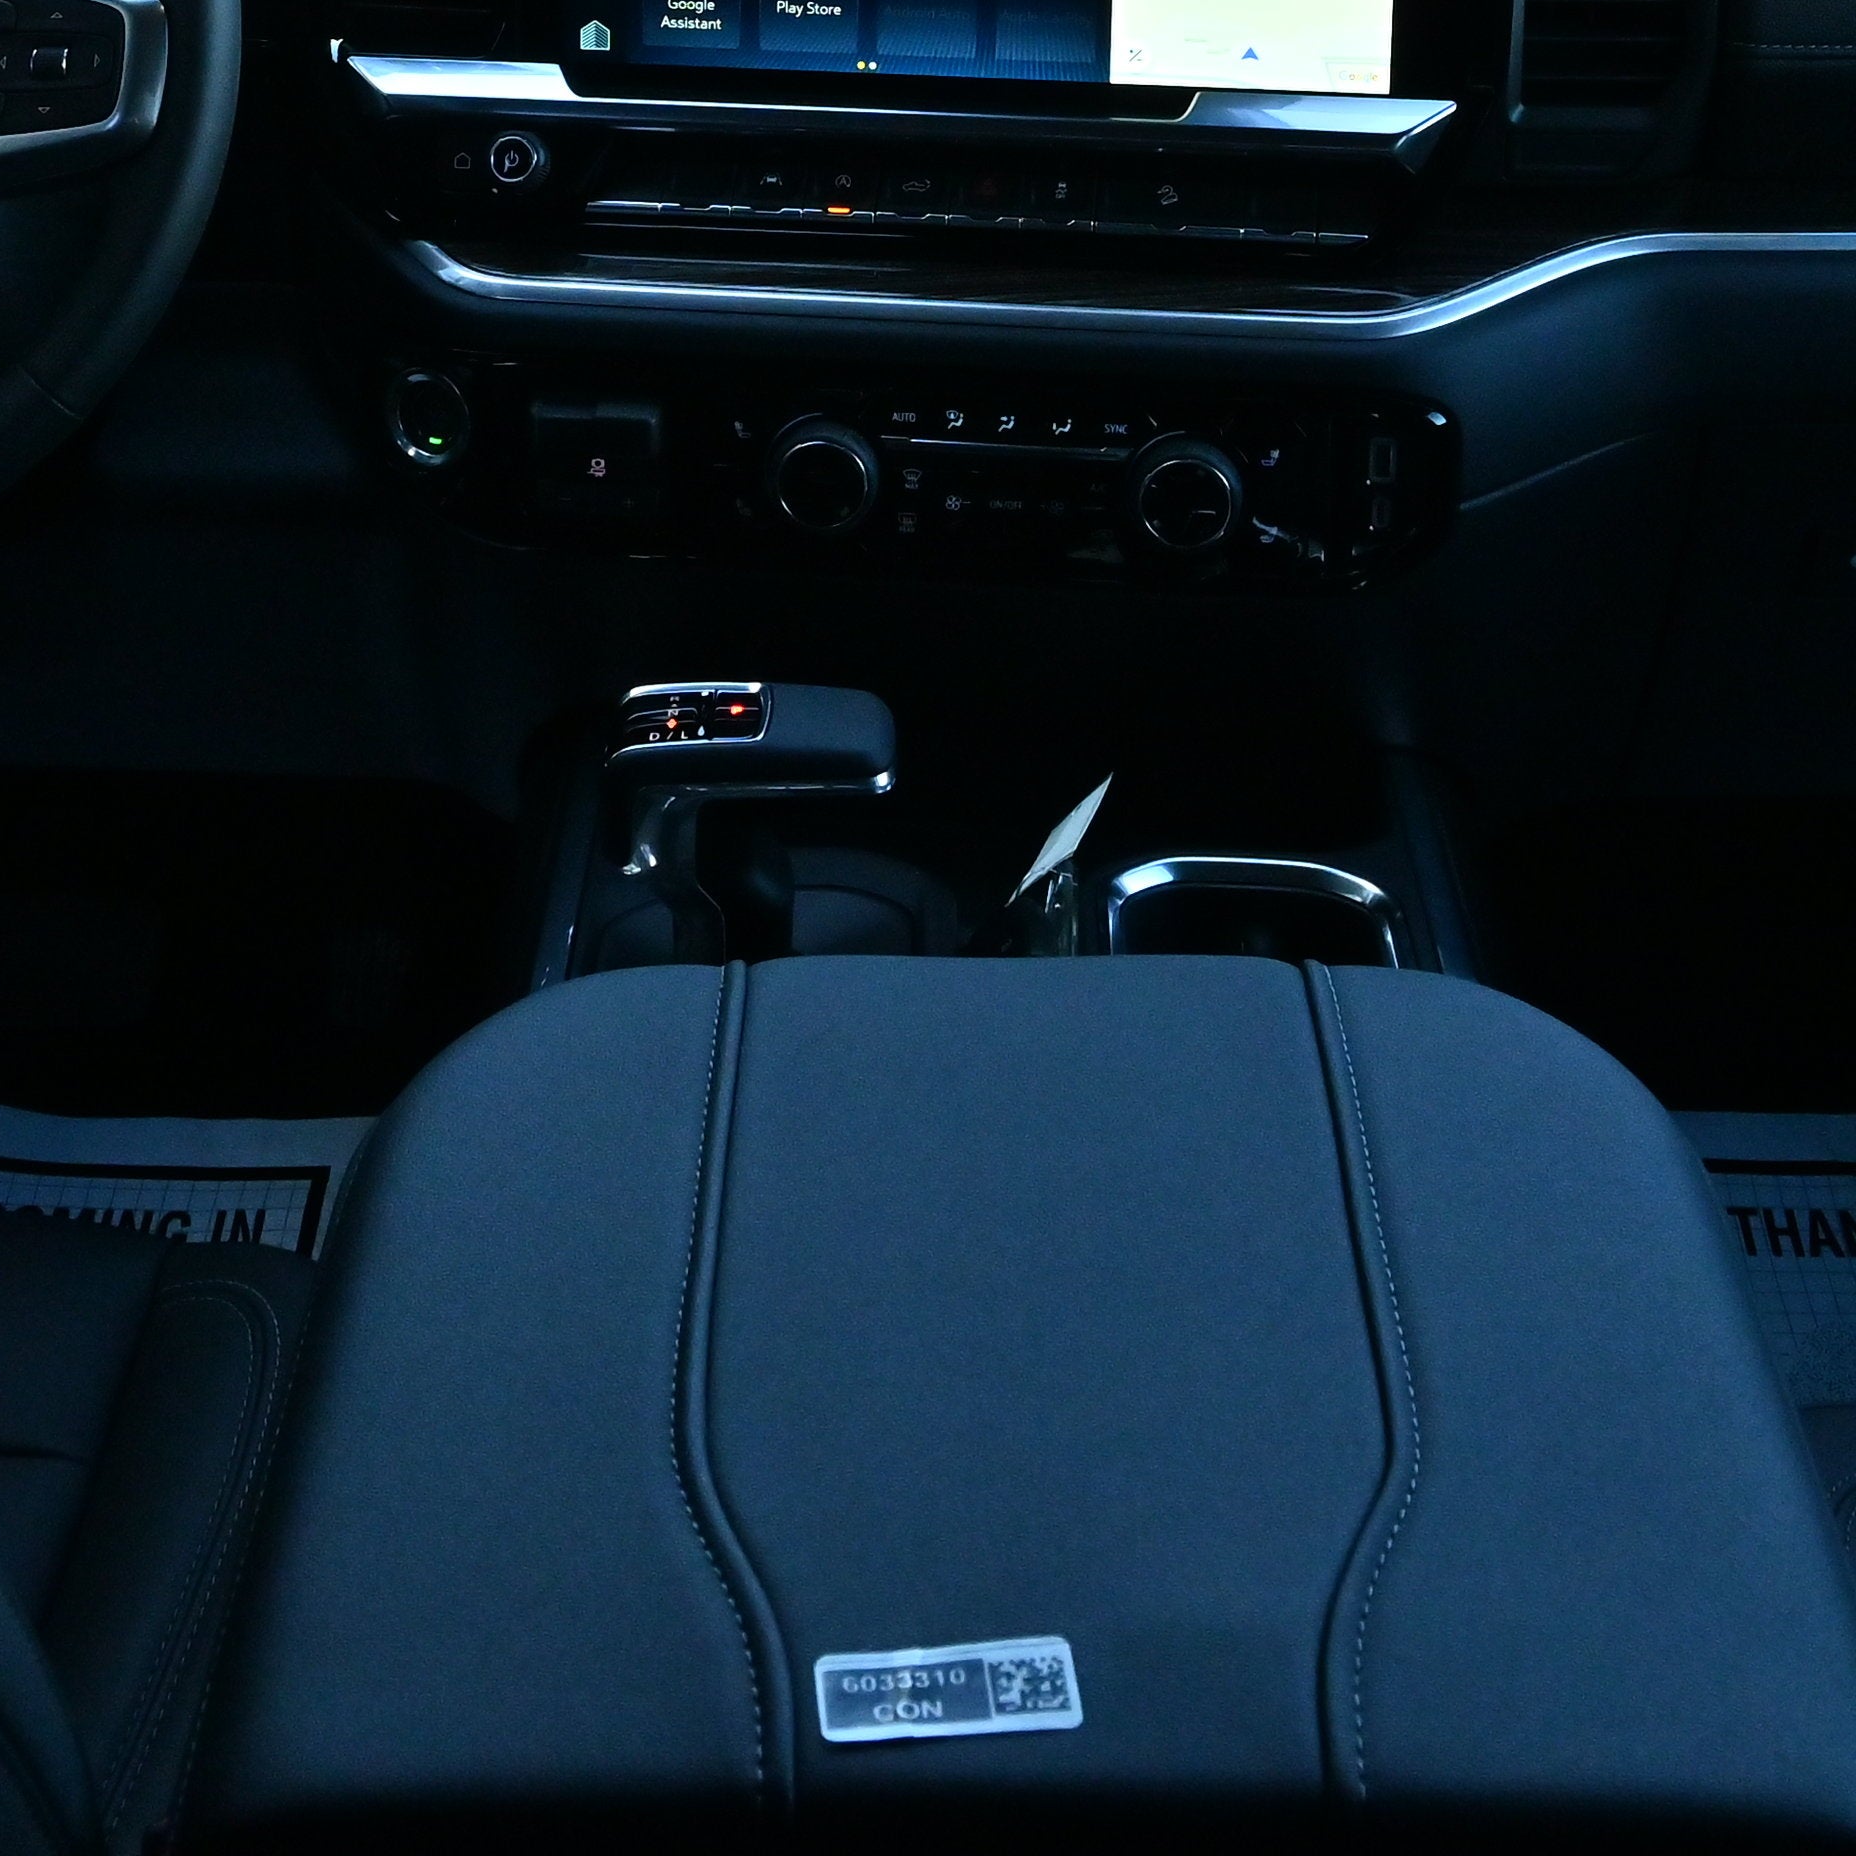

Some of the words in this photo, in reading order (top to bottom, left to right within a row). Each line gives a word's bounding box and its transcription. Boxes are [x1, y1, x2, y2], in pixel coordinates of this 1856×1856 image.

[776, 0, 803, 17] Play
[806, 2, 841, 15] Store
[660, 15, 722, 30] Assistant
[891, 412, 916, 423] AUTO
[1104, 424, 1129, 435] SYNC
[842, 1667, 967, 1694] 6033310
[872, 1699, 945, 1723] CON
